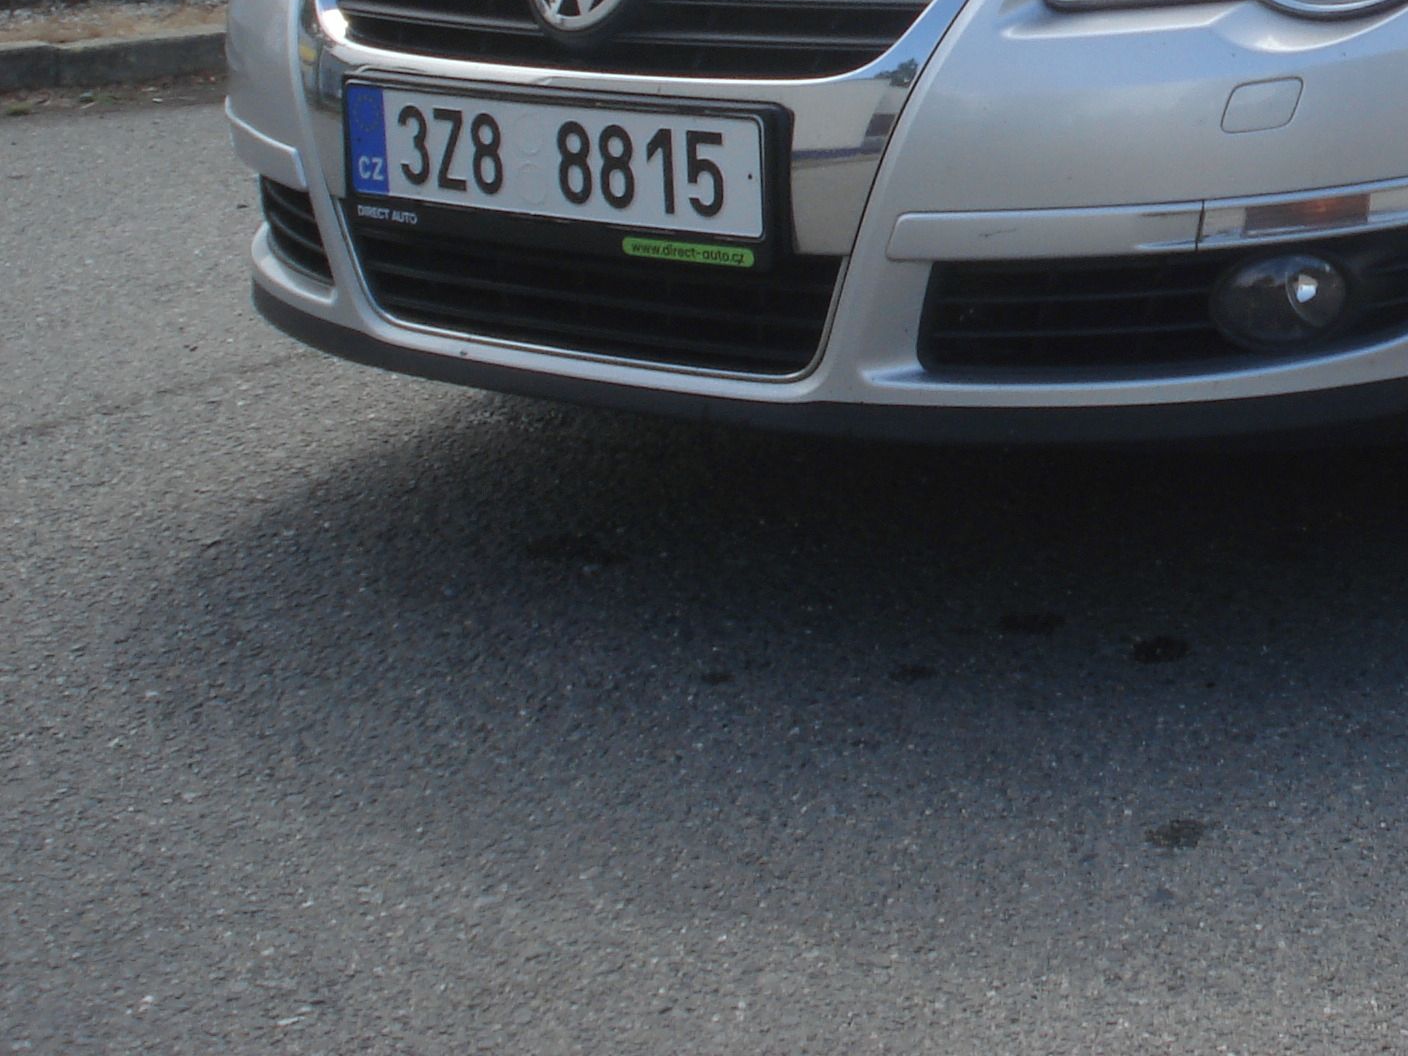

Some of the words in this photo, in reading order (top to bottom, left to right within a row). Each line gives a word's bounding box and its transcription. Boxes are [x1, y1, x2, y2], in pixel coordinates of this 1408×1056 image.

[358, 155, 385, 181] CZ
[398, 105, 503, 194] 3Z8
[557, 120, 724, 218] 8815
[357, 204, 390, 221] DIRECT
[391, 208, 418, 225] AUTO
[631, 243, 745, 265] www.direct-auto.cz
